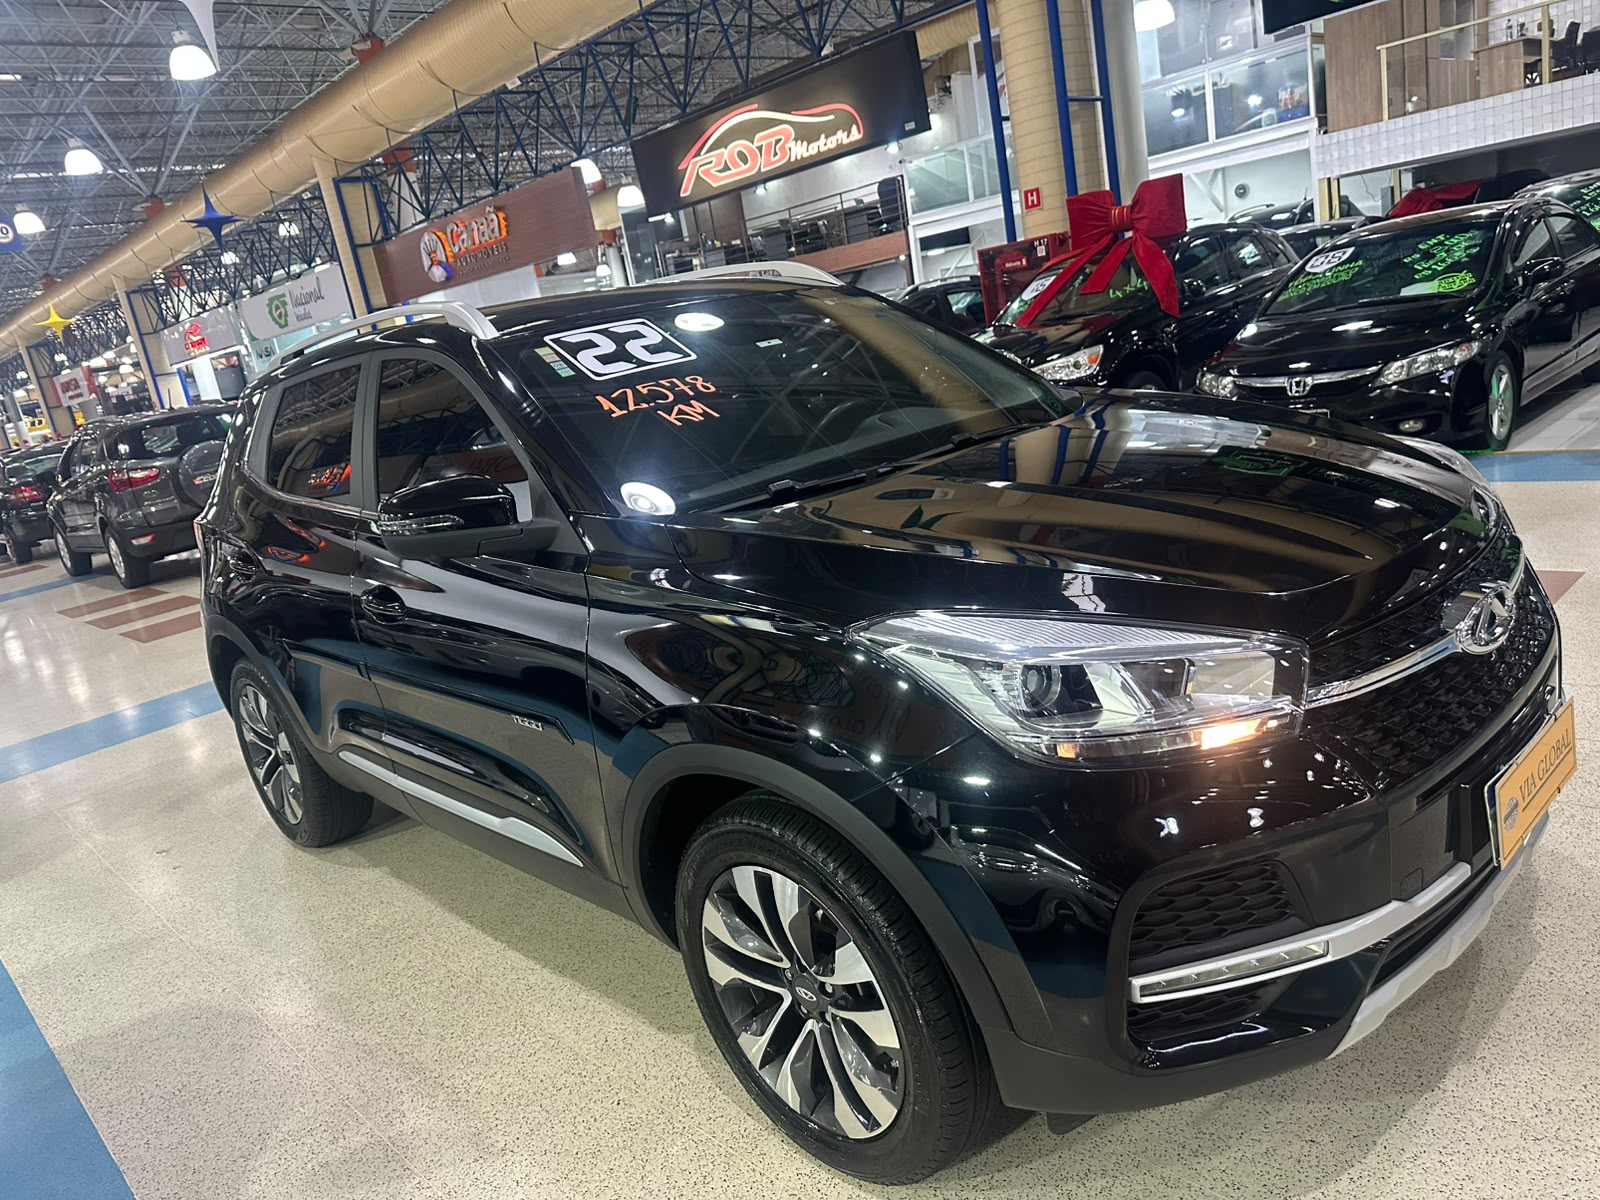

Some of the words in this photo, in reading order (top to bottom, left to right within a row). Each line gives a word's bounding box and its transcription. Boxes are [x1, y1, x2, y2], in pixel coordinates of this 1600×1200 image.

[680, 124, 795, 197] ROB
[1027, 191, 1037, 206] H
[446, 205, 501, 254] Canaã
[288, 276, 325, 309] Nacional
[560, 323, 685, 374] 22
[657, 400, 720, 426] KM
[1519, 771, 1538, 803] VIA
[1537, 727, 1572, 782] GLOBAL
